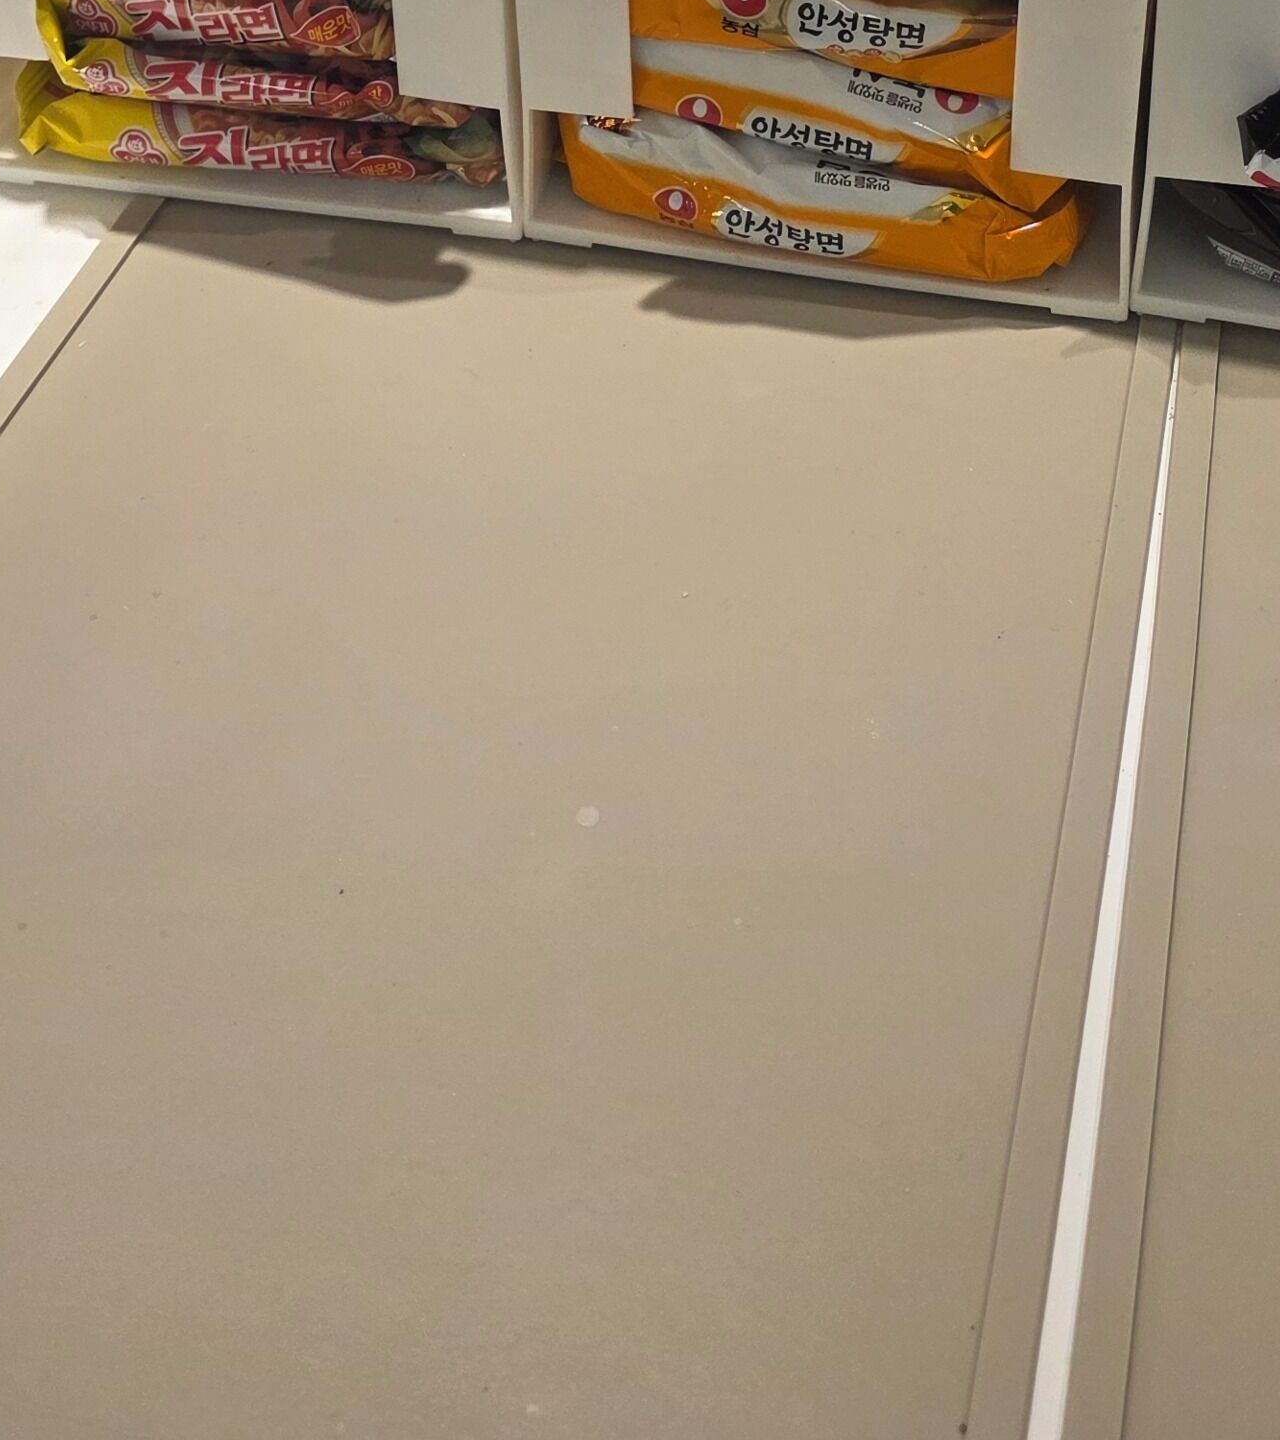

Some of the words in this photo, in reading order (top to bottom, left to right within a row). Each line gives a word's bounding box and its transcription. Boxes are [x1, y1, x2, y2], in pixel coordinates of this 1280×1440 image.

[307, 12, 352, 42] 매운맛
[720, 16, 761, 39] 농심
[797, 2, 927, 50] 안성탕면
[359, 161, 404, 177] 매운맛
[724, 209, 846, 256] 안성탕면
